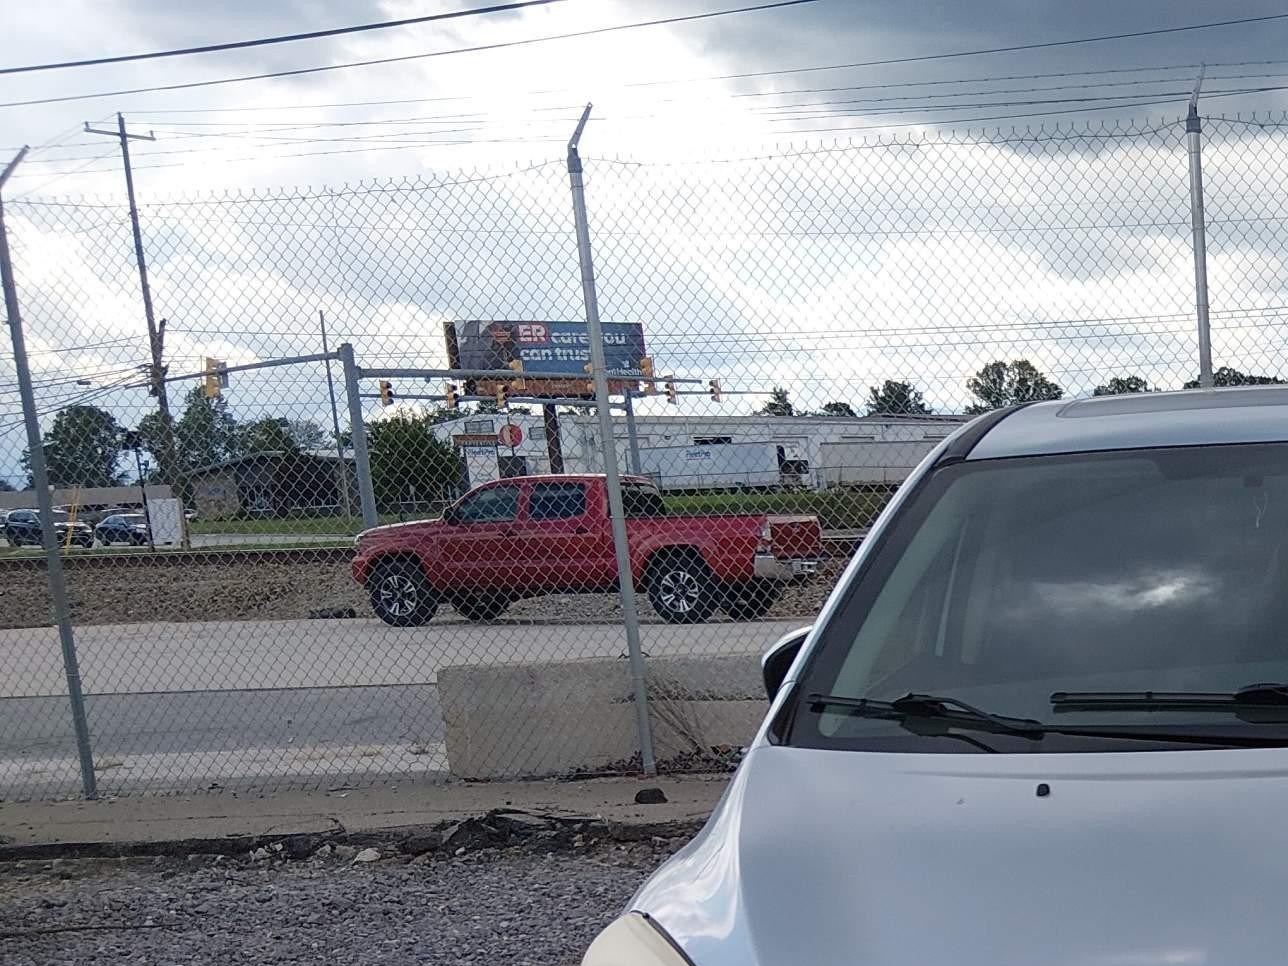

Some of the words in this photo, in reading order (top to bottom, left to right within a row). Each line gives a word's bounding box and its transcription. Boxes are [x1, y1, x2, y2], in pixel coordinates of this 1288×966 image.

[518, 324, 546, 342] ER
[550, 331, 590, 344] care
[600, 332, 626, 345] ou
[520, 348, 553, 361] can
